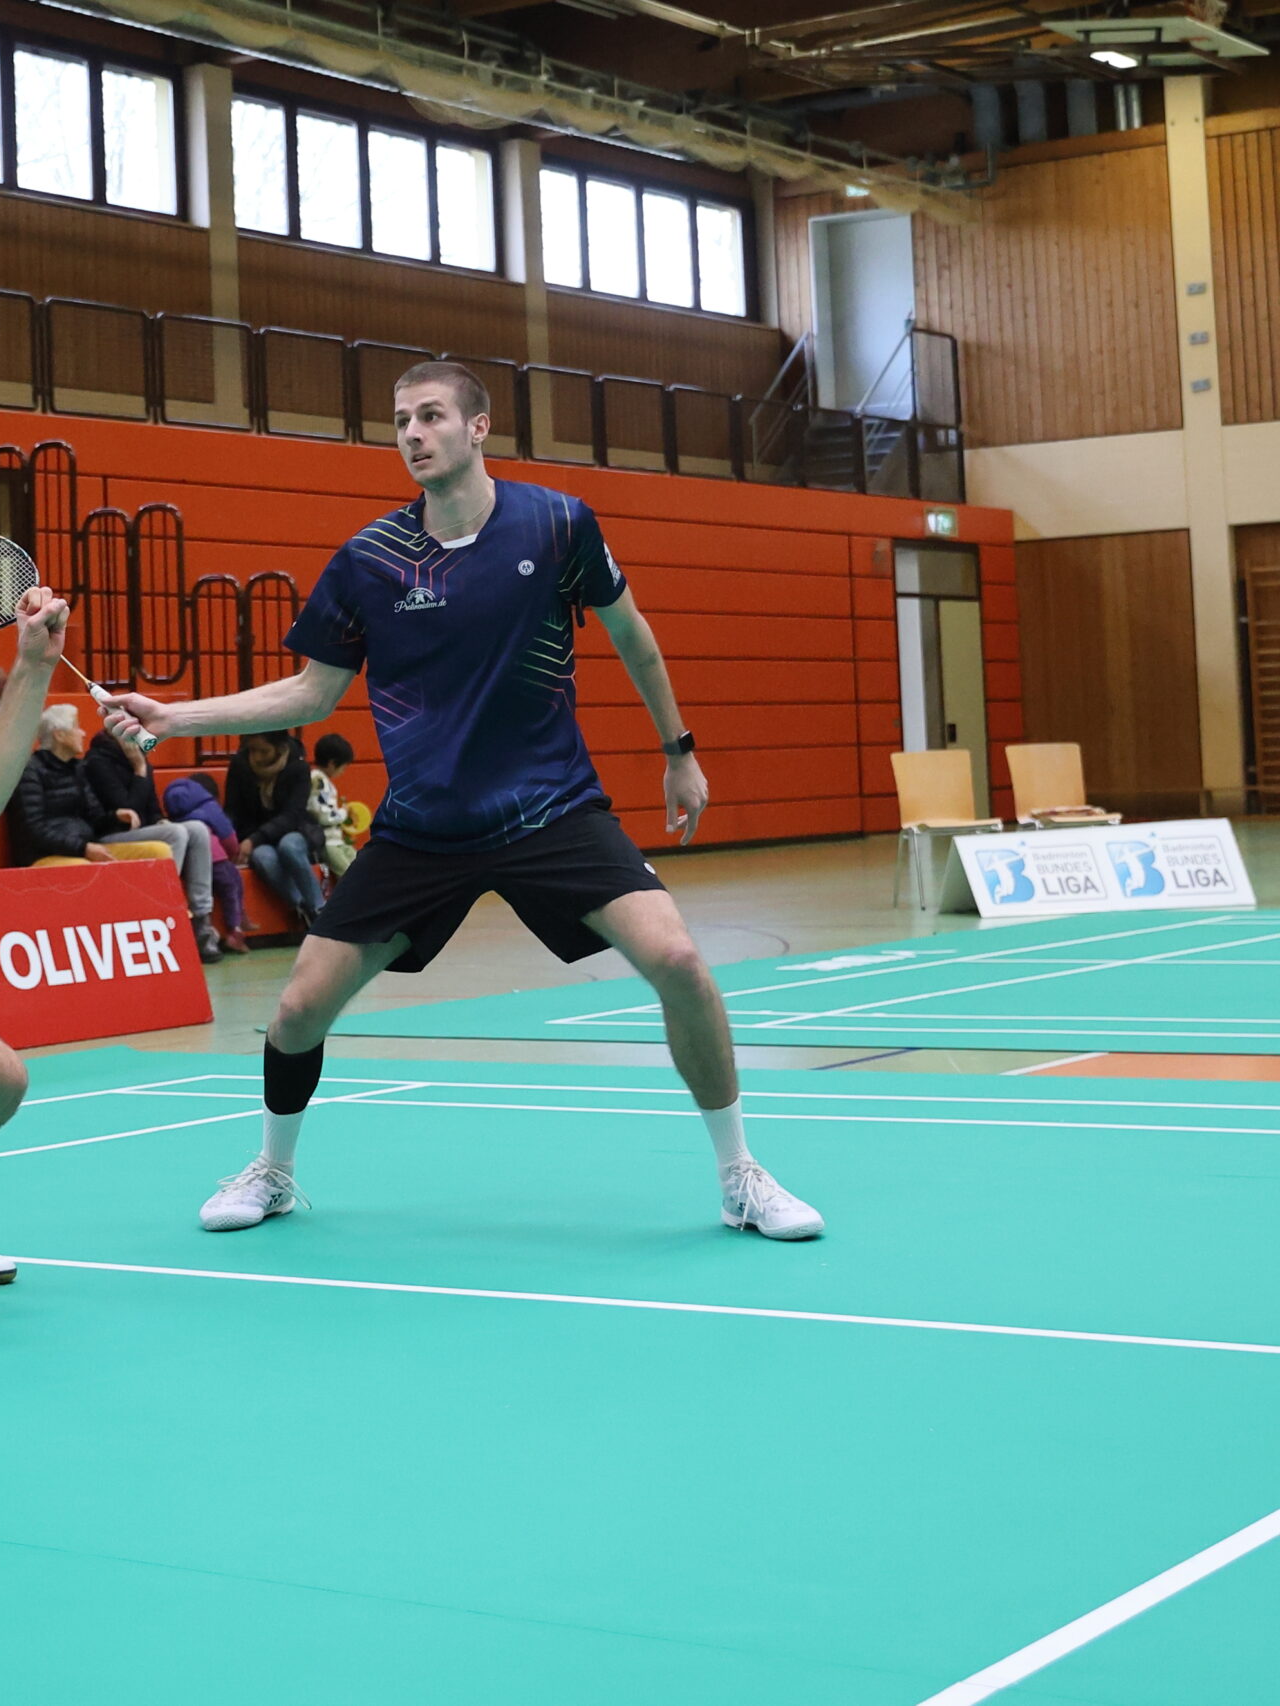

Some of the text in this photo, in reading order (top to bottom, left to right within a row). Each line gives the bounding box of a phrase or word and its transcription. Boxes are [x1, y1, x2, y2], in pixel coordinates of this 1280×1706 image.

[1032, 851, 1088, 861] Badminton
[1166, 854, 1221, 866] BUNDES
[1036, 862, 1092, 874] BUNDES
[1171, 868, 1229, 888] LIGA
[1041, 876, 1100, 895] LIGA
